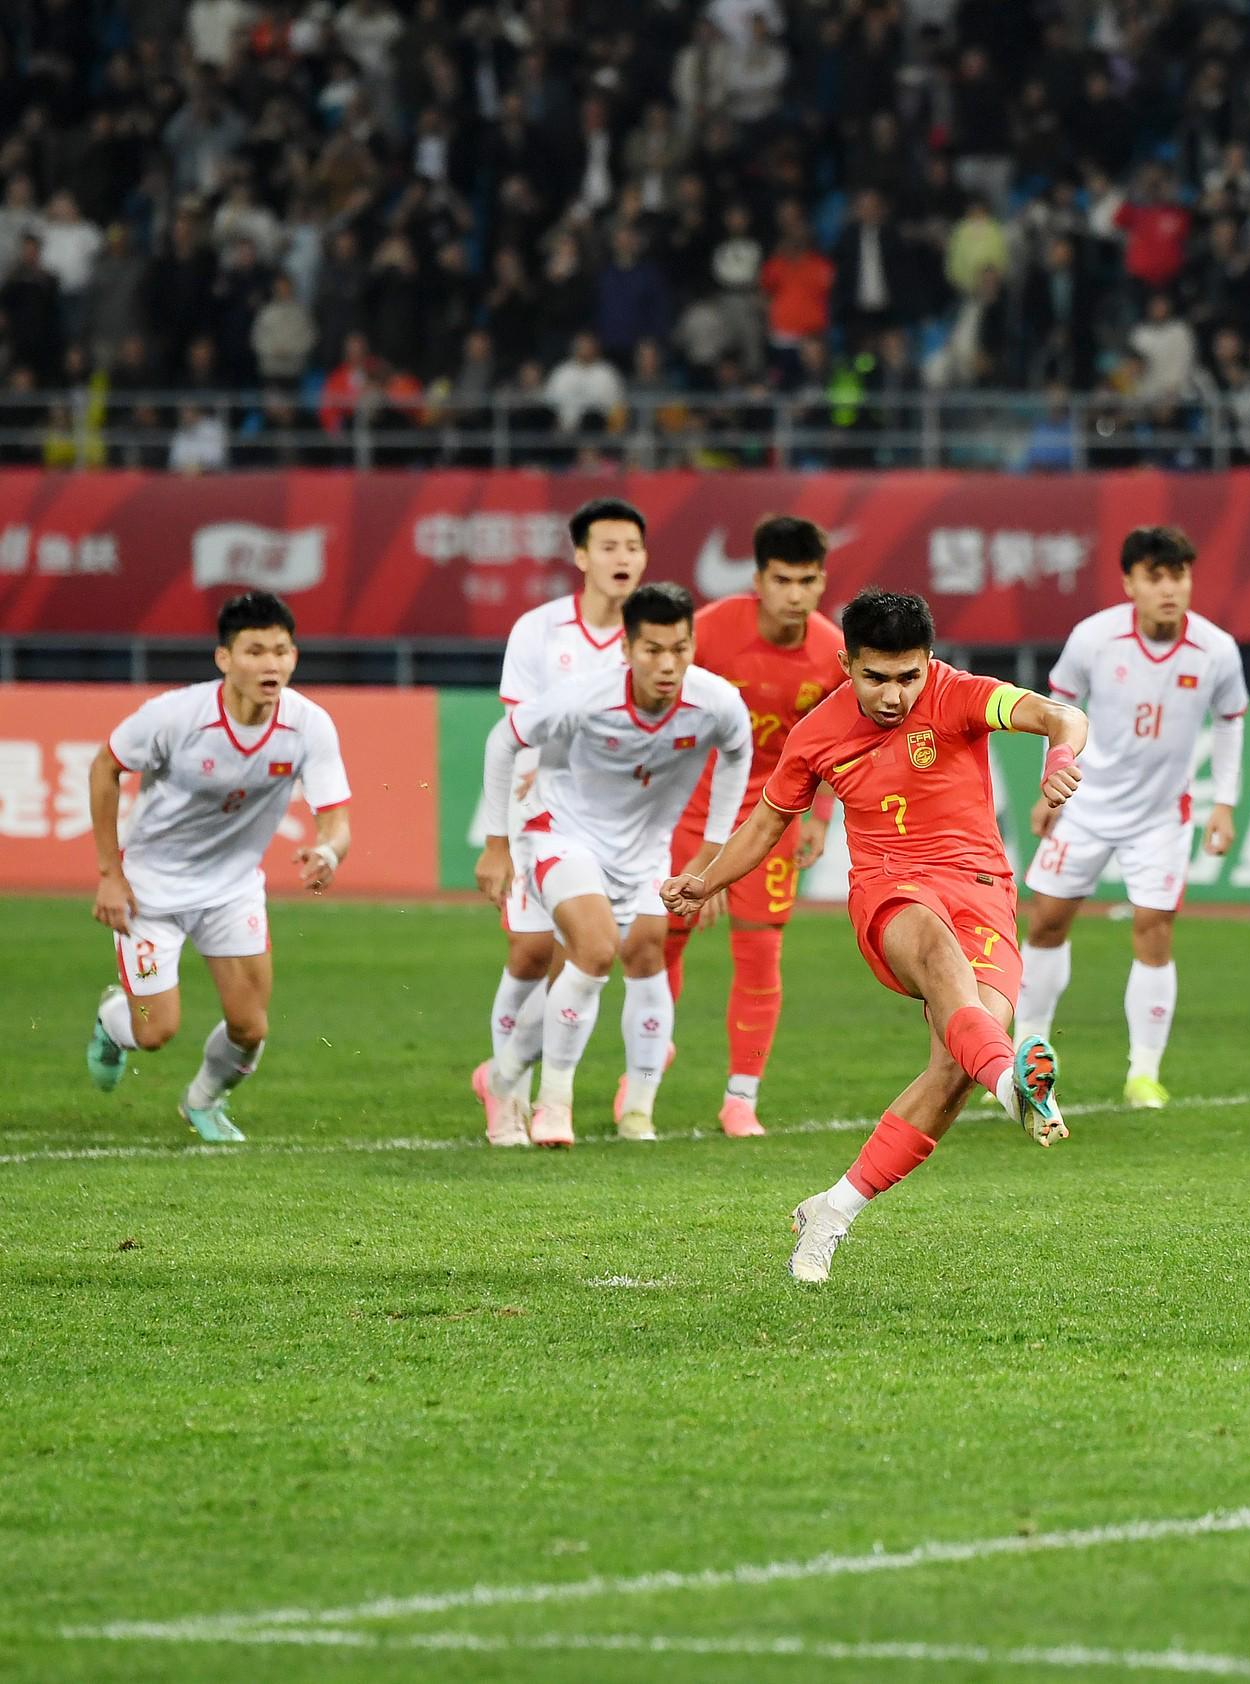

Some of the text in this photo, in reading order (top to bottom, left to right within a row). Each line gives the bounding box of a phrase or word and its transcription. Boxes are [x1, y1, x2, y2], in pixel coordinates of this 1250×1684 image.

[910, 733, 931, 743] CFA
[633, 764, 651, 786] 4
[881, 795, 907, 836] 7
[974, 926, 1001, 957] 7
